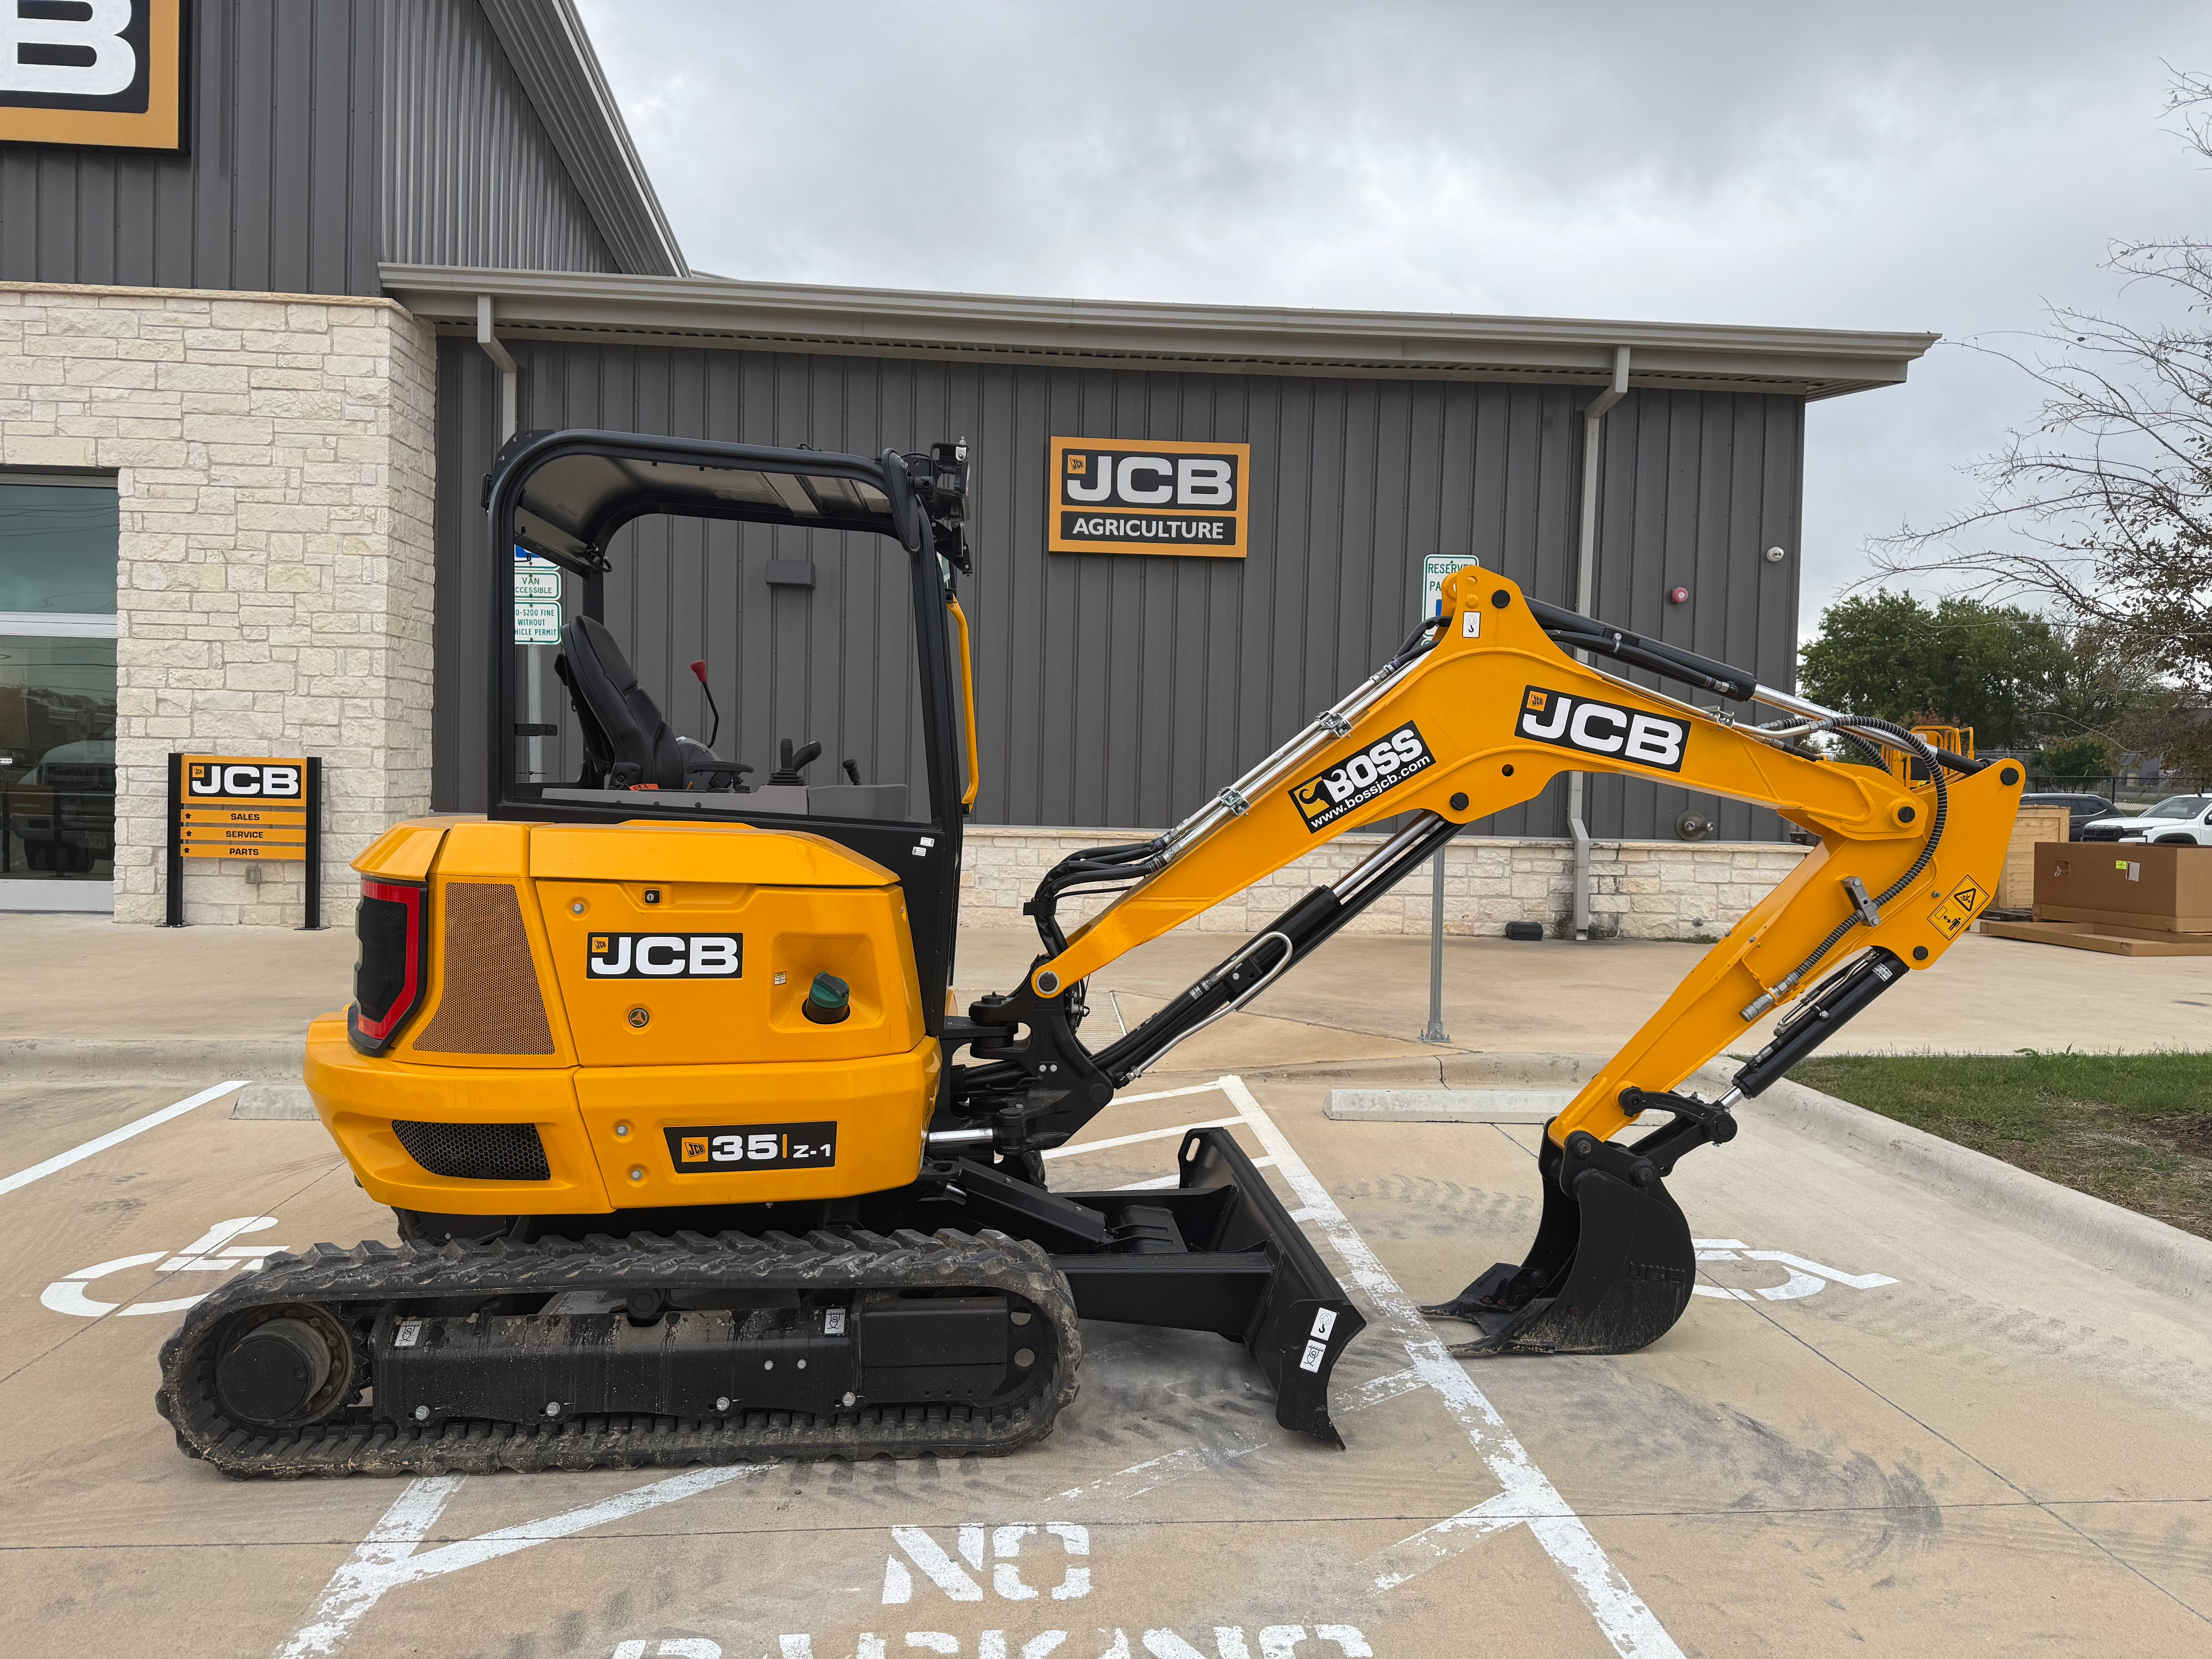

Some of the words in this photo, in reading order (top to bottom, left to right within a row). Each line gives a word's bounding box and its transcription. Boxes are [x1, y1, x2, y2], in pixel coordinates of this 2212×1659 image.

[1068, 456, 1232, 505] JCB
[1072, 460, 1083, 469] JCB
[1072, 518, 1224, 539] AGRICULTURE
[1428, 563, 1473, 574] RESERV
[1533, 696, 1542, 704] JCB
[1522, 697, 1683, 764] JCB
[192, 766, 299, 795] JCB
[1323, 729, 1422, 803] BOSS
[1310, 756, 1431, 828] www.bossjcb.com
[591, 936, 738, 975] JCB
[688, 1144, 704, 1156] JCB
[712, 1134, 778, 1161] 35
[881, 1521, 1094, 1604] NO
